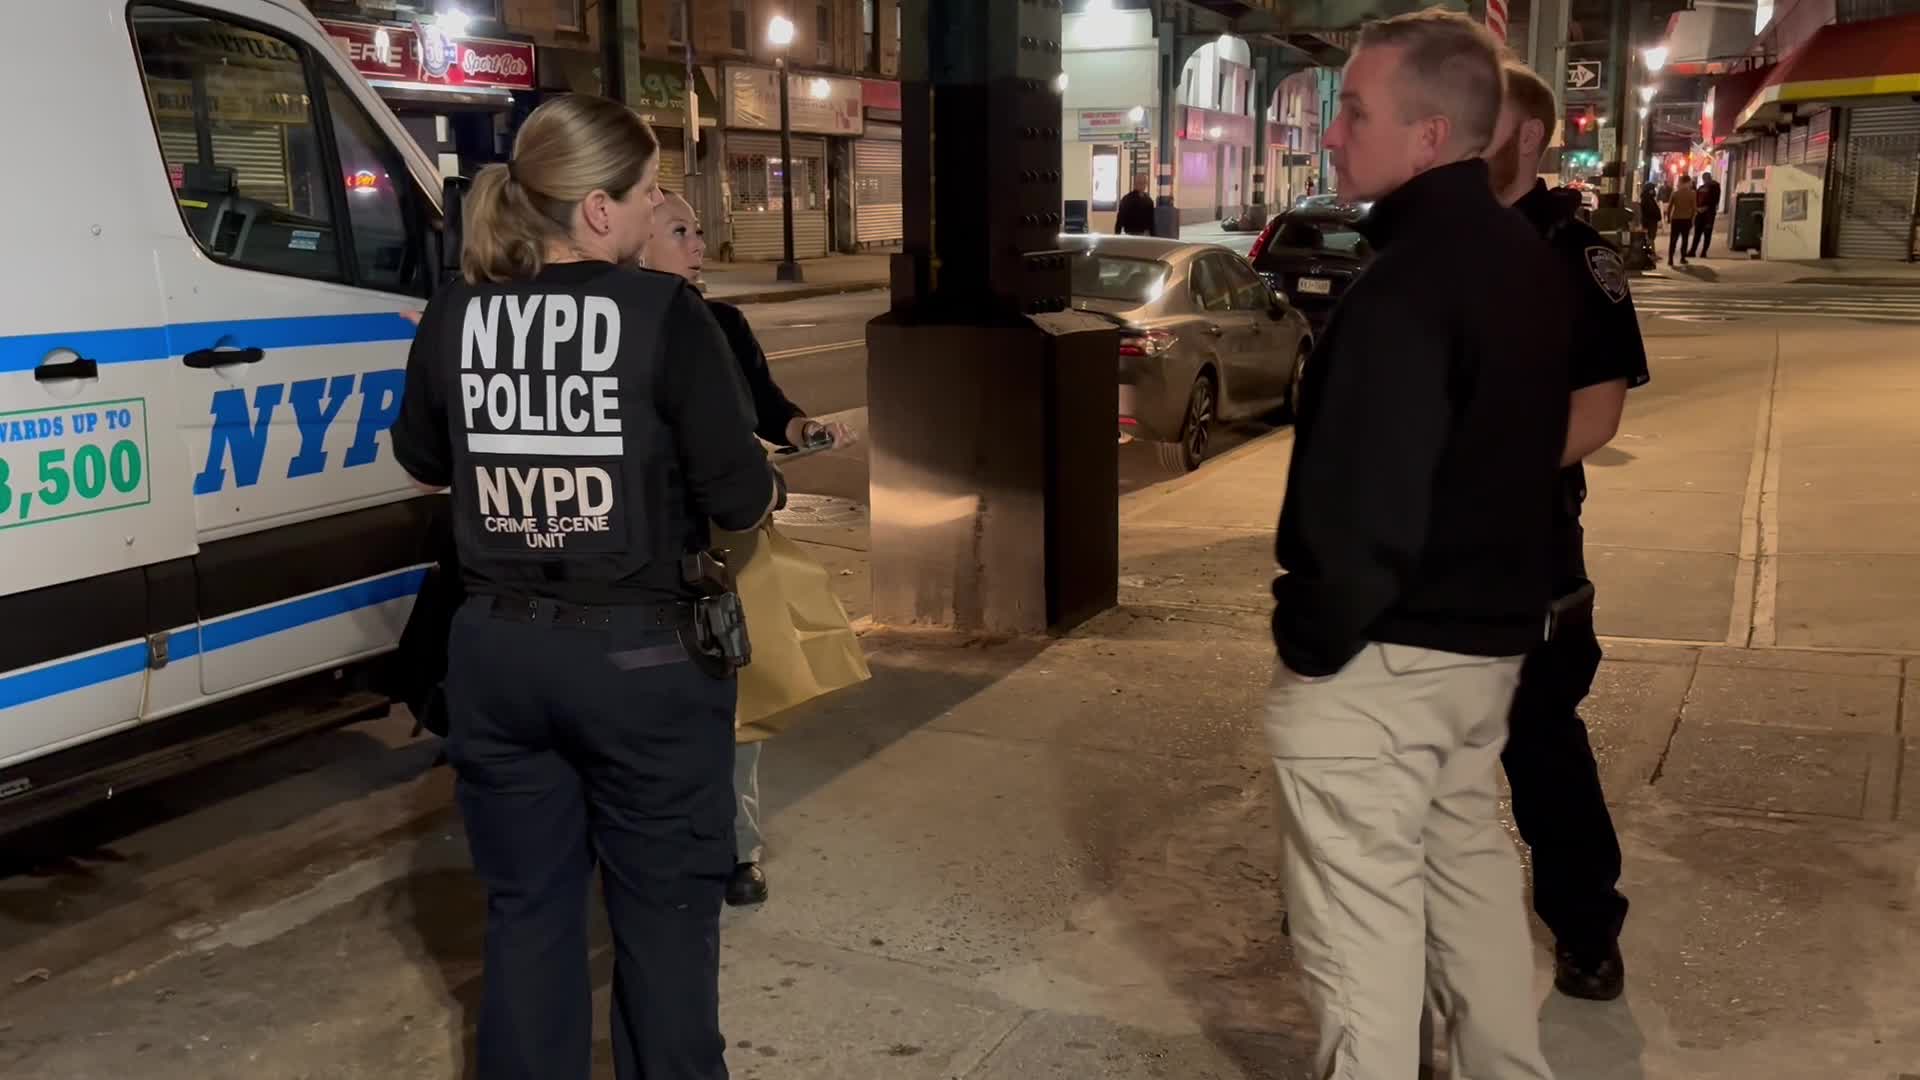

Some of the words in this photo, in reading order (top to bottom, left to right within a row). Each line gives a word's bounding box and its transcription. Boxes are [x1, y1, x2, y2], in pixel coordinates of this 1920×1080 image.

[463, 49, 500, 76] Sport
[501, 53, 527, 76] Bar
[461, 294, 621, 372] NYPD
[72, 412, 98, 434] UP
[106, 409, 131, 430] TO
[460, 373, 622, 432] POLICE
[193, 368, 406, 495] NYP
[475, 466, 614, 517] NYPD
[485, 516, 538, 533] CRIME
[547, 516, 610, 533] SCENE
[526, 533, 566, 548] UNIT
